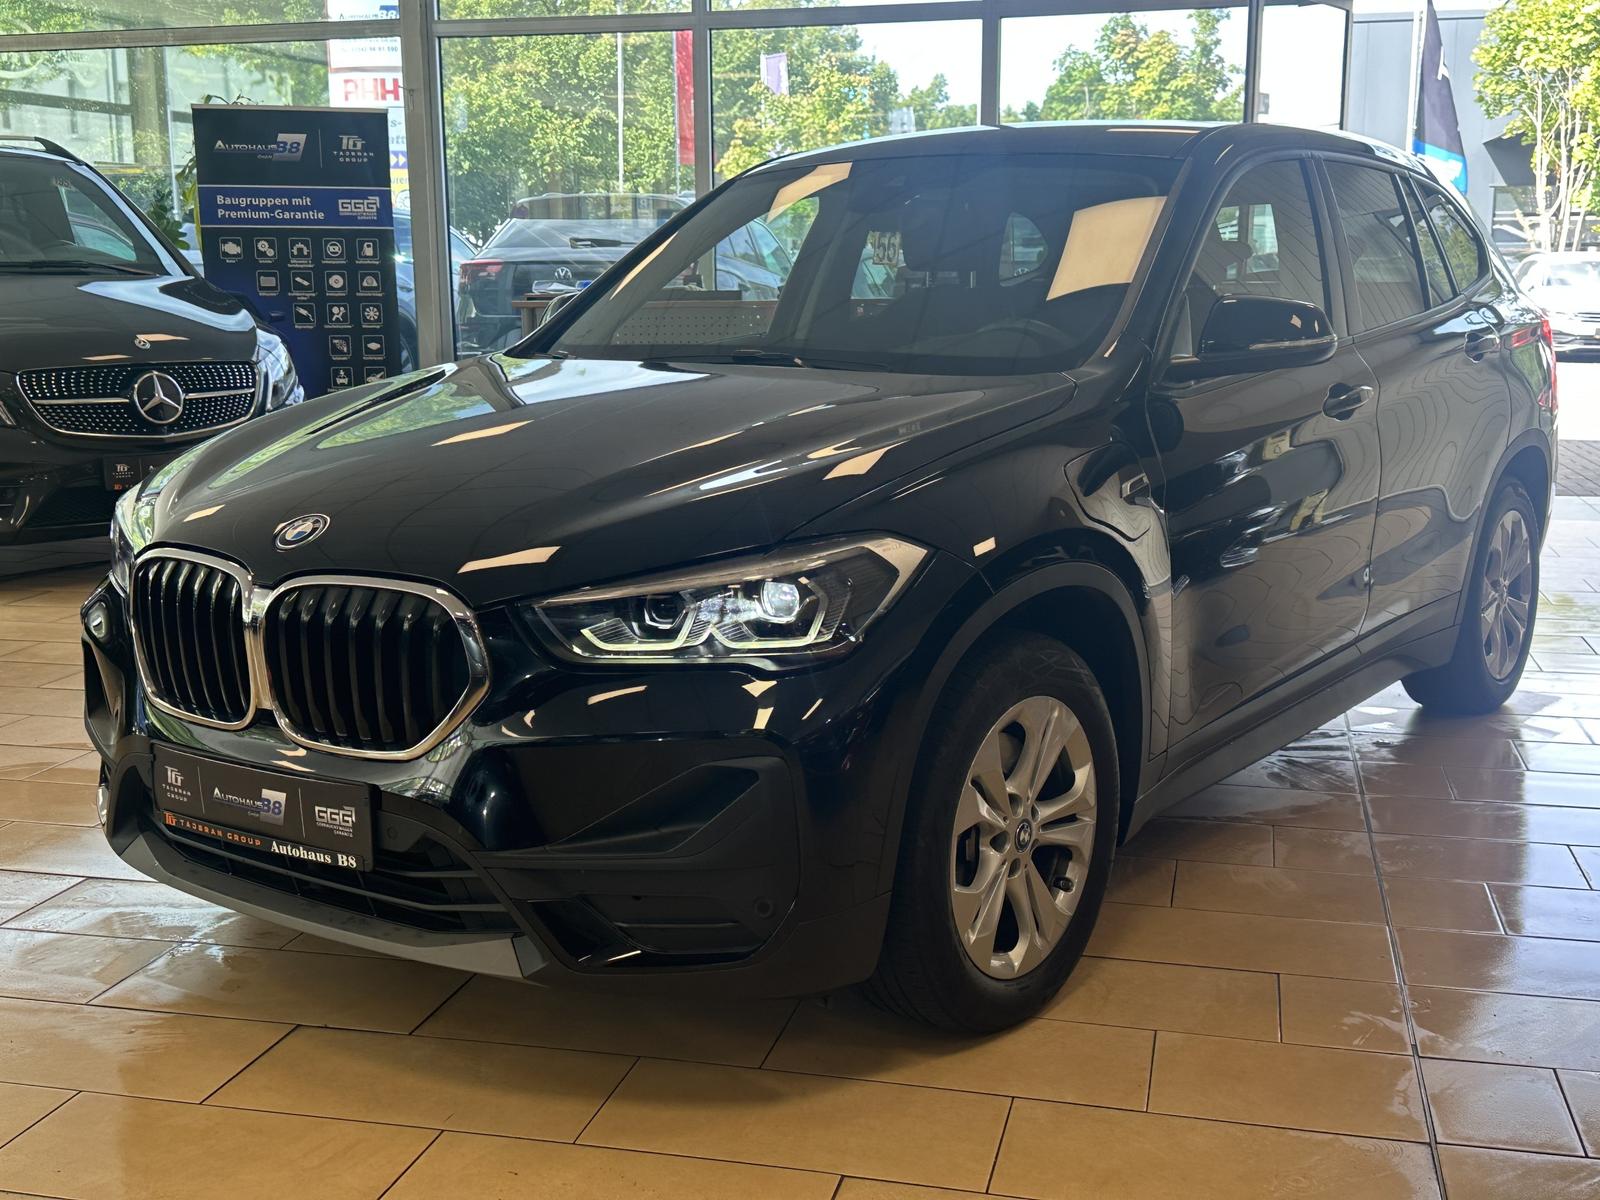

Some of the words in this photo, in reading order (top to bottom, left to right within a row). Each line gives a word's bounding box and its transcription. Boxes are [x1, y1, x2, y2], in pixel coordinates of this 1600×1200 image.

[276, 141, 301, 154] B8
[216, 194, 289, 207] Baugruppen
[292, 195, 312, 206] mit
[338, 196, 380, 212] GGG
[217, 208, 325, 220] Premium-Garantie
[166, 792, 188, 803] GROUP
[261, 797, 282, 816] B8
[314, 805, 355, 828] GGG
[226, 832, 262, 847] GROUP
[271, 840, 332, 864] Autohaus
[337, 853, 357, 869] B8
